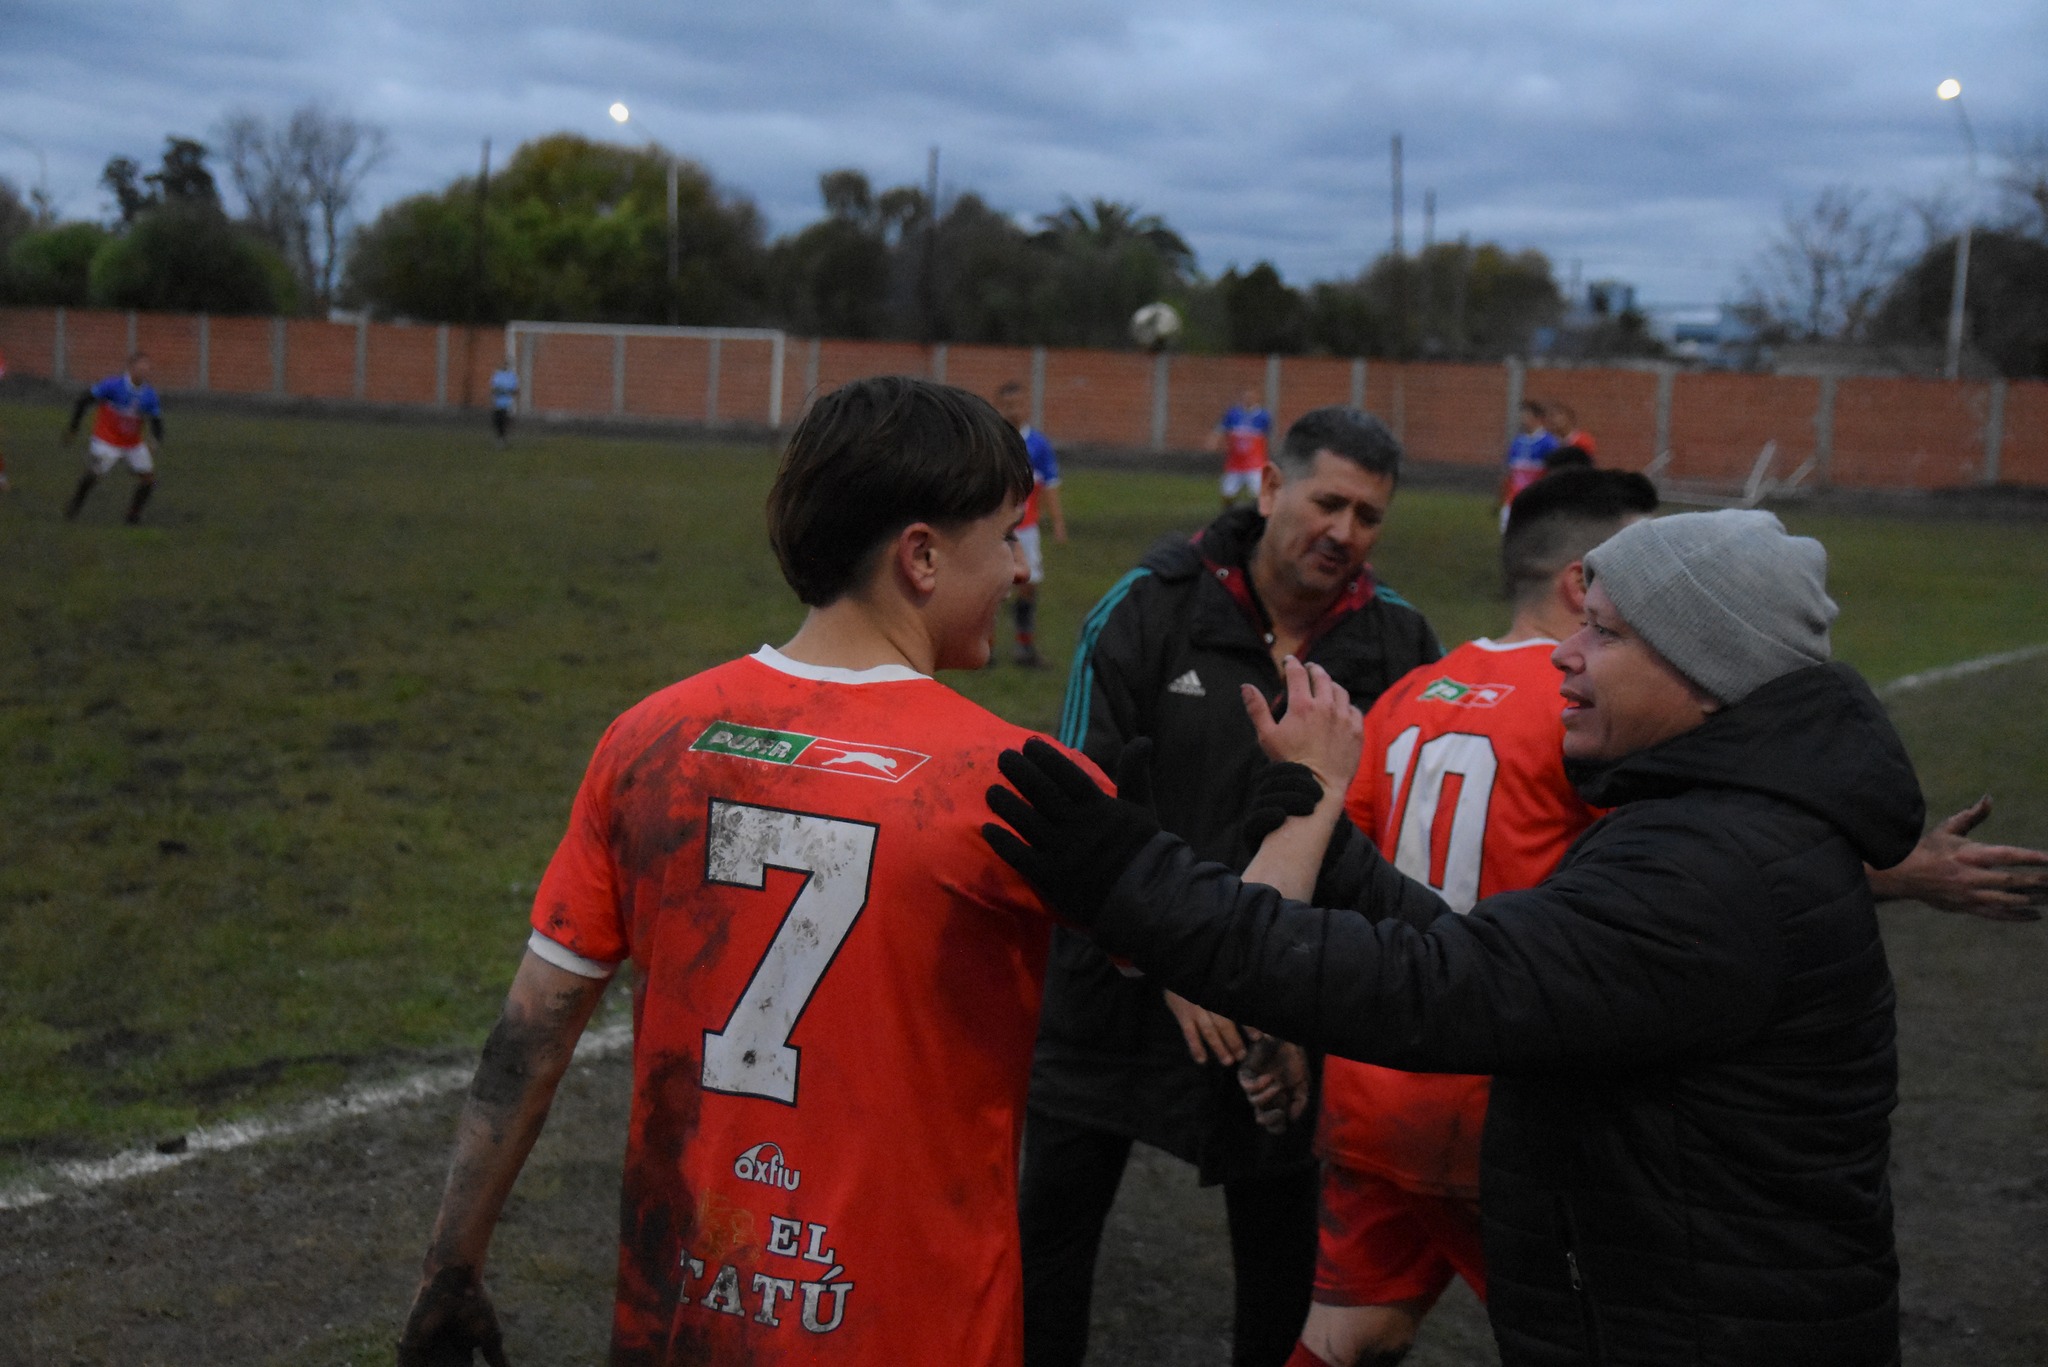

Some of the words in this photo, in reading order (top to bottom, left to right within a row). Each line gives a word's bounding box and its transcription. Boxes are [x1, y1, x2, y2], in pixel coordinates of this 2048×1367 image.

[709, 730, 793, 759] PUMA
[1385, 724, 1498, 916] 10
[702, 797, 879, 1107] 7
[766, 1214, 836, 1265] EL
